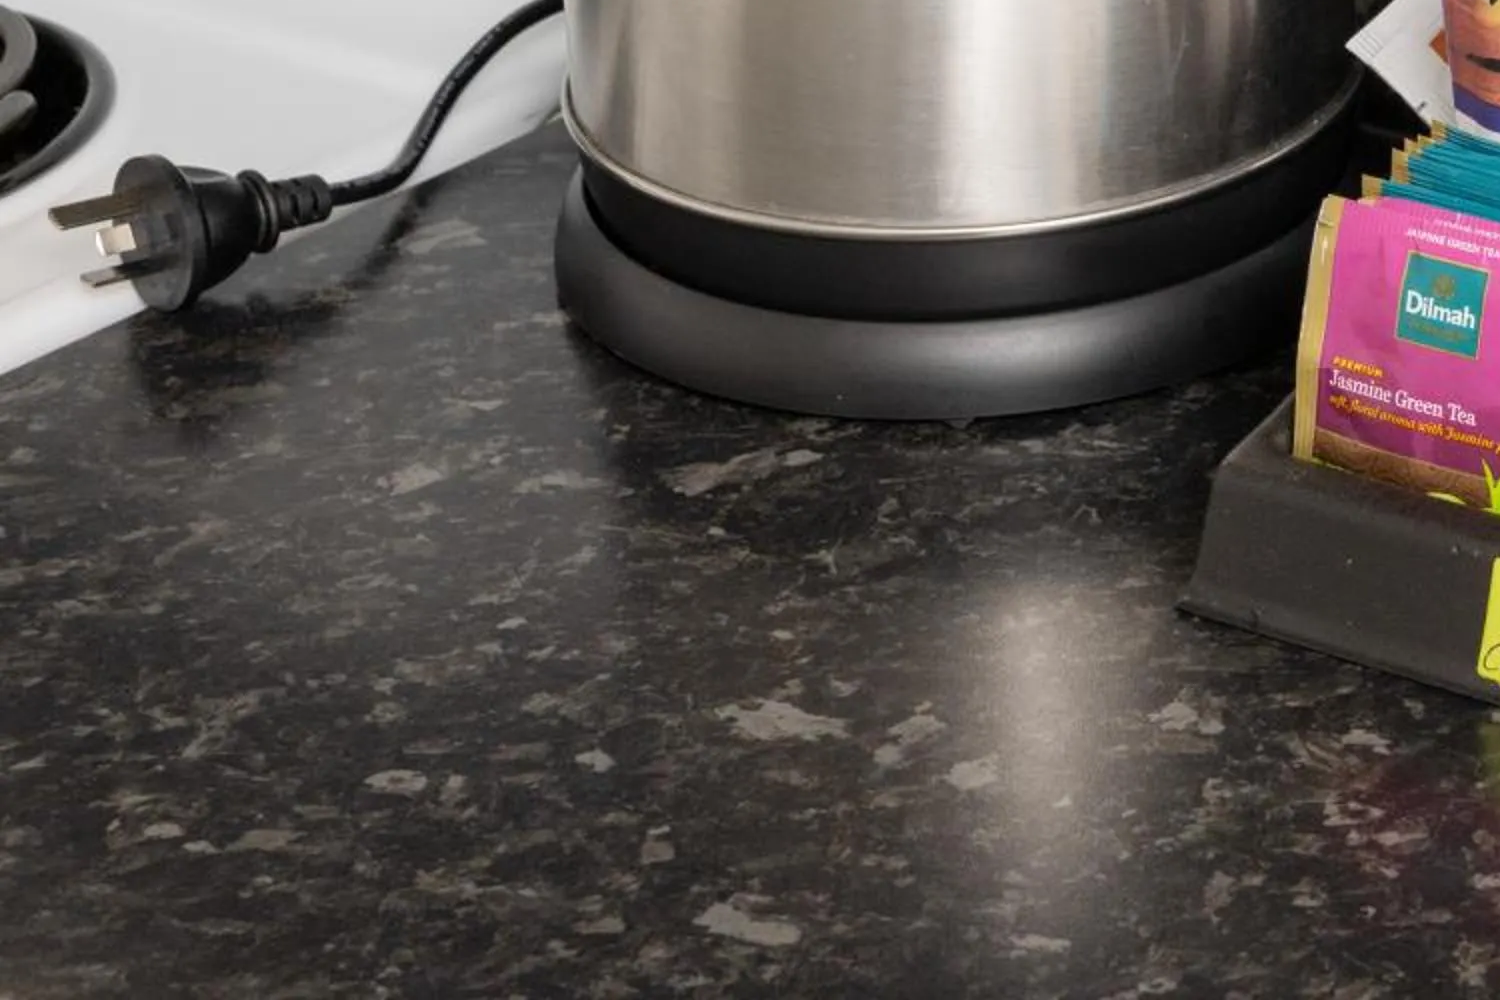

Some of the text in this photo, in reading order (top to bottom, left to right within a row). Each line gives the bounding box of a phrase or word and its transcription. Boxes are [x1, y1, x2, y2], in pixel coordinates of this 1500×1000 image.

[1405, 289, 1476, 330] Dilmah
[1329, 369, 1478, 427] Jasmine Green Tea
